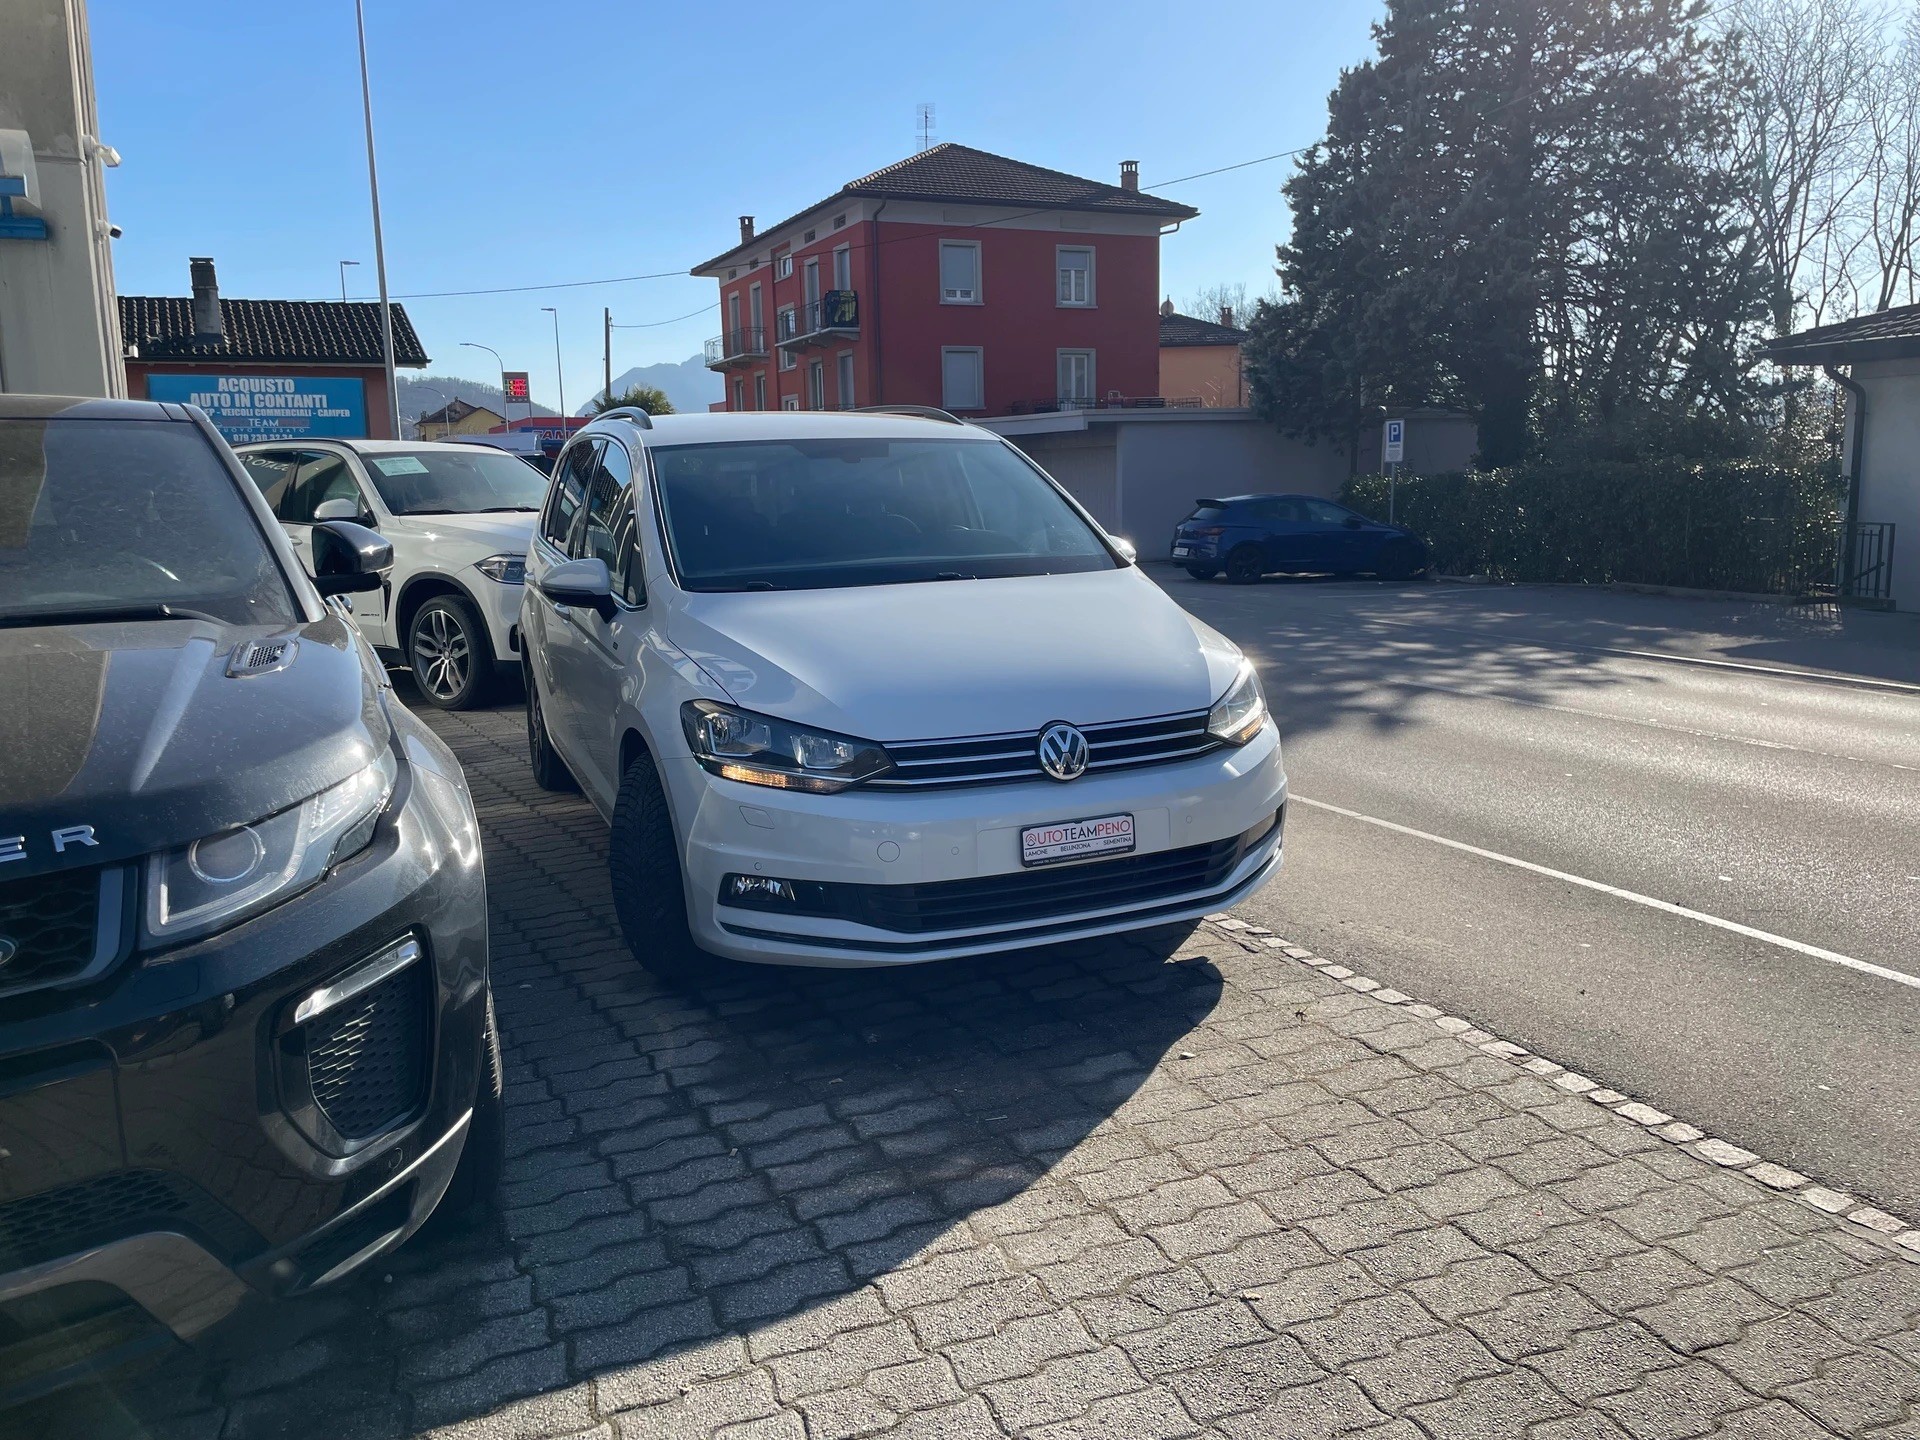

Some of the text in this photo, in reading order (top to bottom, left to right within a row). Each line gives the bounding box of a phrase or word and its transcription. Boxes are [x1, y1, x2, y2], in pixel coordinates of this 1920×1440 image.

[218, 377, 295, 394] ACQUISTO
[190, 392, 328, 408] AUTO IN CONTANTI
[221, 408, 254, 417] VEICOLI
[255, 409, 312, 417] COMMERCIALI
[317, 409, 351, 418] CAMPER
[248, 418, 279, 427] TEAM
[232, 433, 249, 442] 079
[1390, 424, 1399, 441] P
[1025, 848, 1049, 858] LAMONE
[1060, 843, 1091, 853] BELLINZONA
[1103, 836, 1132, 846] SEMENTINA
